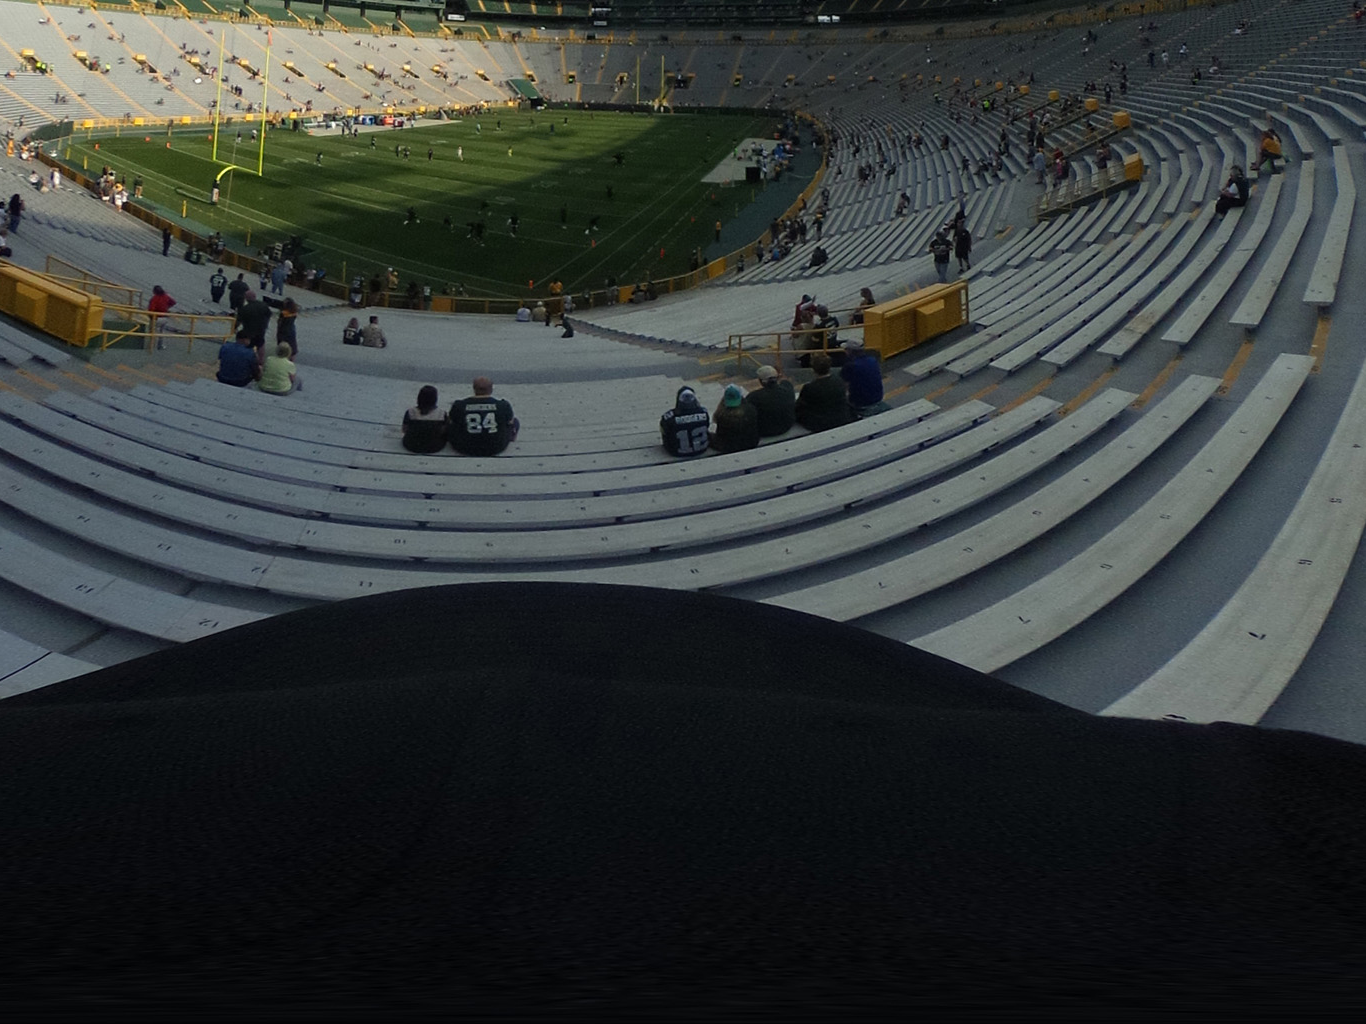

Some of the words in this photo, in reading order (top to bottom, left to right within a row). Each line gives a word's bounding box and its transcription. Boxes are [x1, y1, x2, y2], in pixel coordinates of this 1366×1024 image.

[466, 412, 498, 434] 84
[676, 425, 709, 454] 12
[1017, 616, 1031, 624] 7
[1248, 631, 1267, 640] 7
